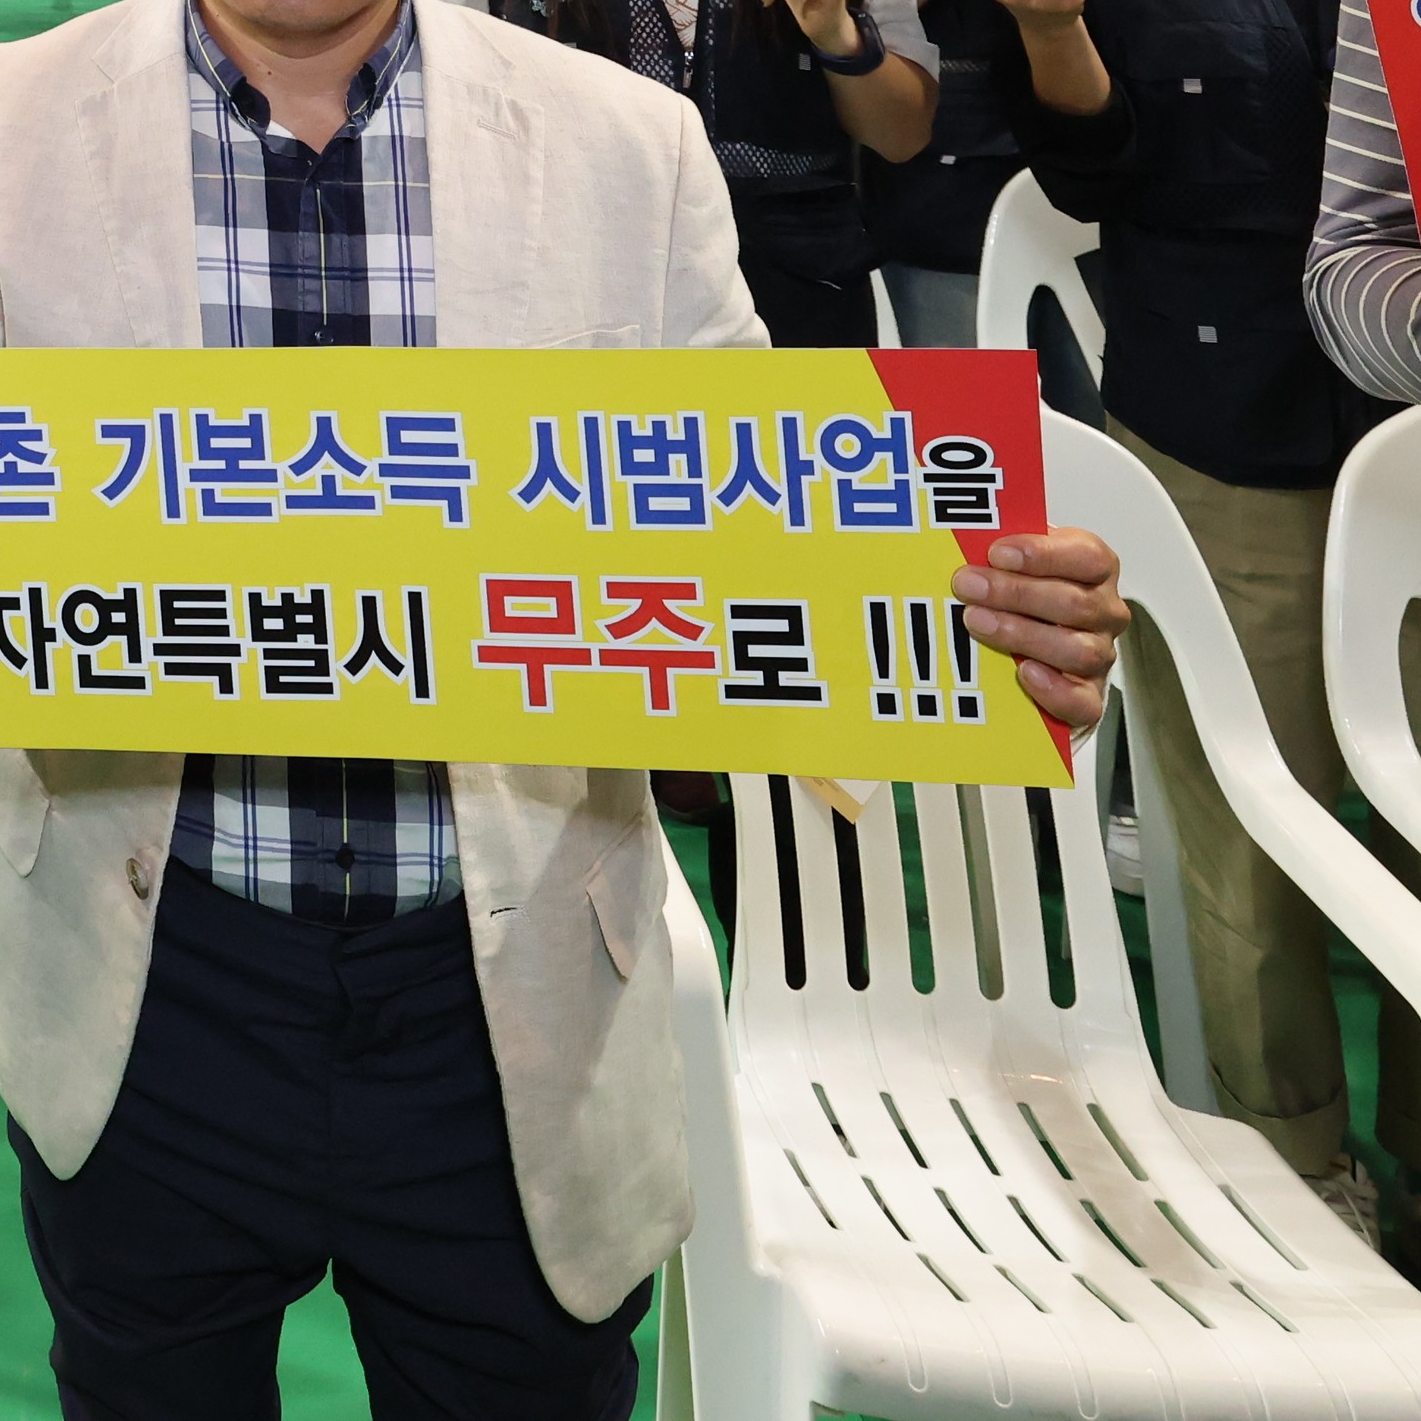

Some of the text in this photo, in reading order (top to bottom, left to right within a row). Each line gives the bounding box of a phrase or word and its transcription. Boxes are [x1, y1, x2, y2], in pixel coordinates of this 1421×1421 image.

[93, 408, 476, 529] 기본소득
[513, 410, 1000, 530] 시범사업을
[472, 574, 829, 716] 무주로
[868, 594, 982, 724] !!!
